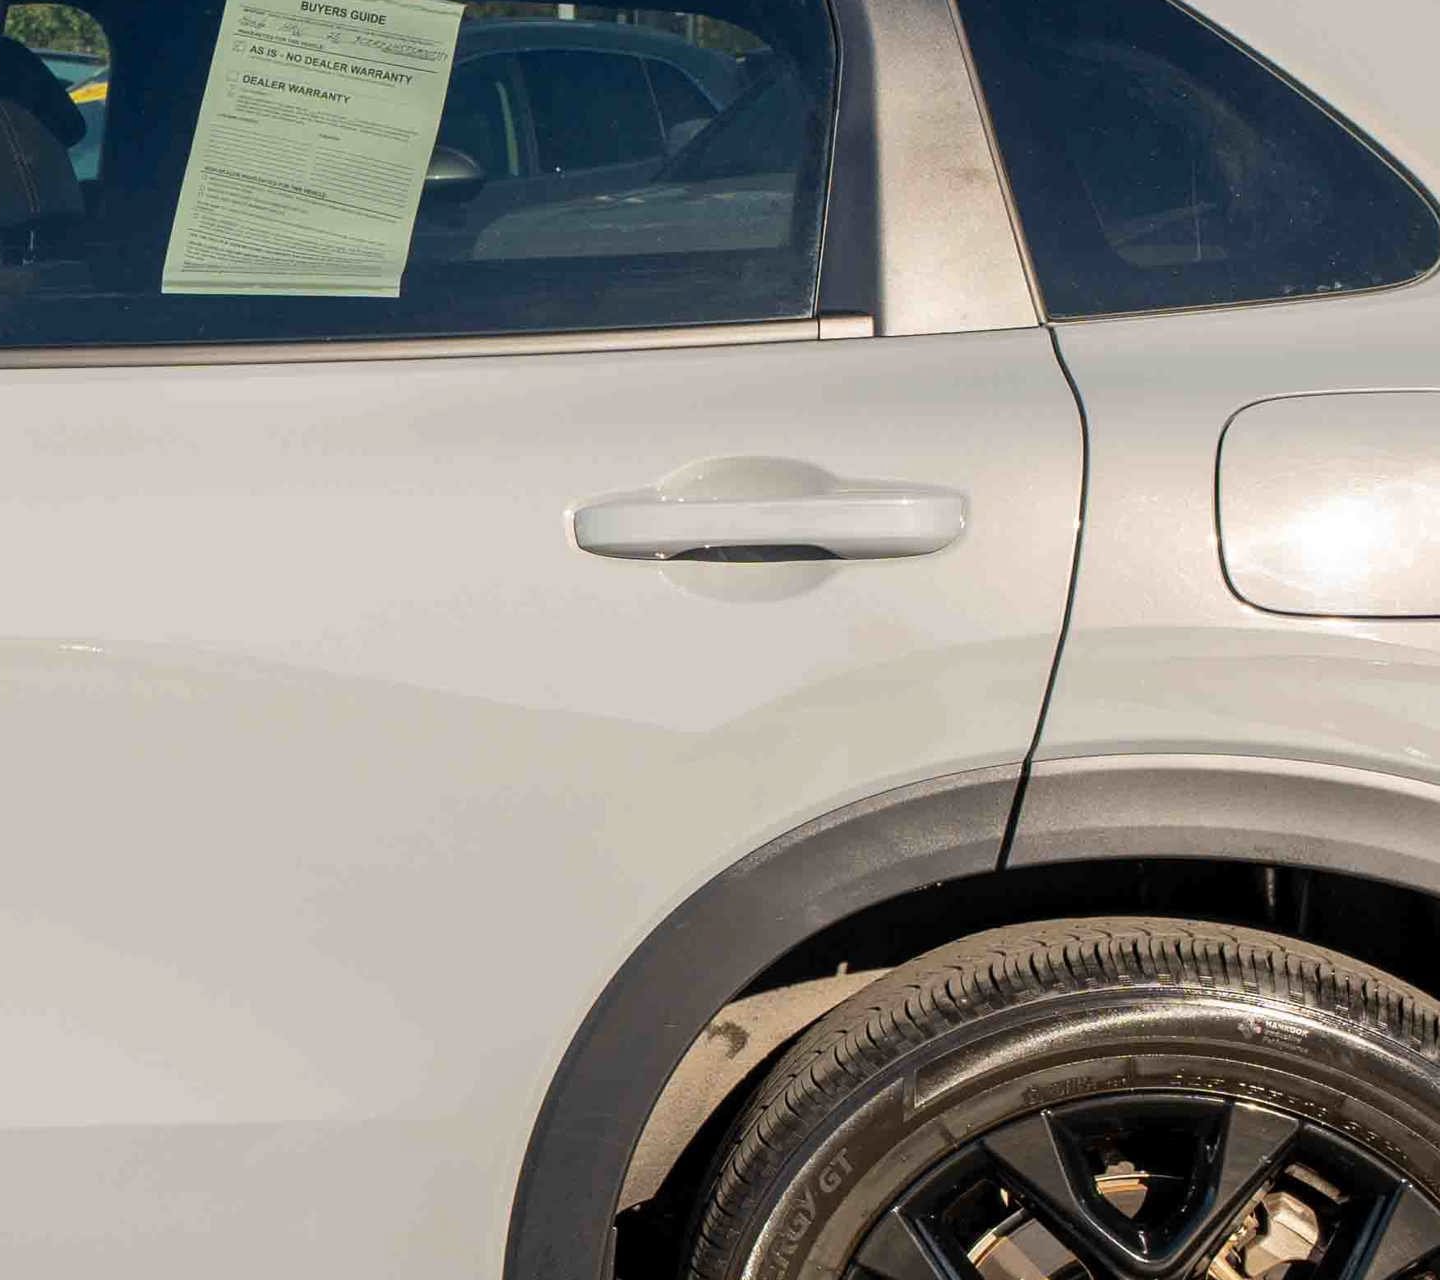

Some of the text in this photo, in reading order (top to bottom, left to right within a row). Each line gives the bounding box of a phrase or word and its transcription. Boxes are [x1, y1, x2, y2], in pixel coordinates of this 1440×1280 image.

[300, 0, 348, 19] BUYERS
[350, 9, 387, 26] GUIDE
[249, 45, 265, 57] AS
[266, 47, 278, 58] IS
[286, 51, 303, 63] NO
[304, 56, 349, 74] DEALER
[350, 65, 414, 85] WARRANTY
[242, 74, 351, 105] DEALER WARRANTY
[819, 1147, 855, 1195] GT
